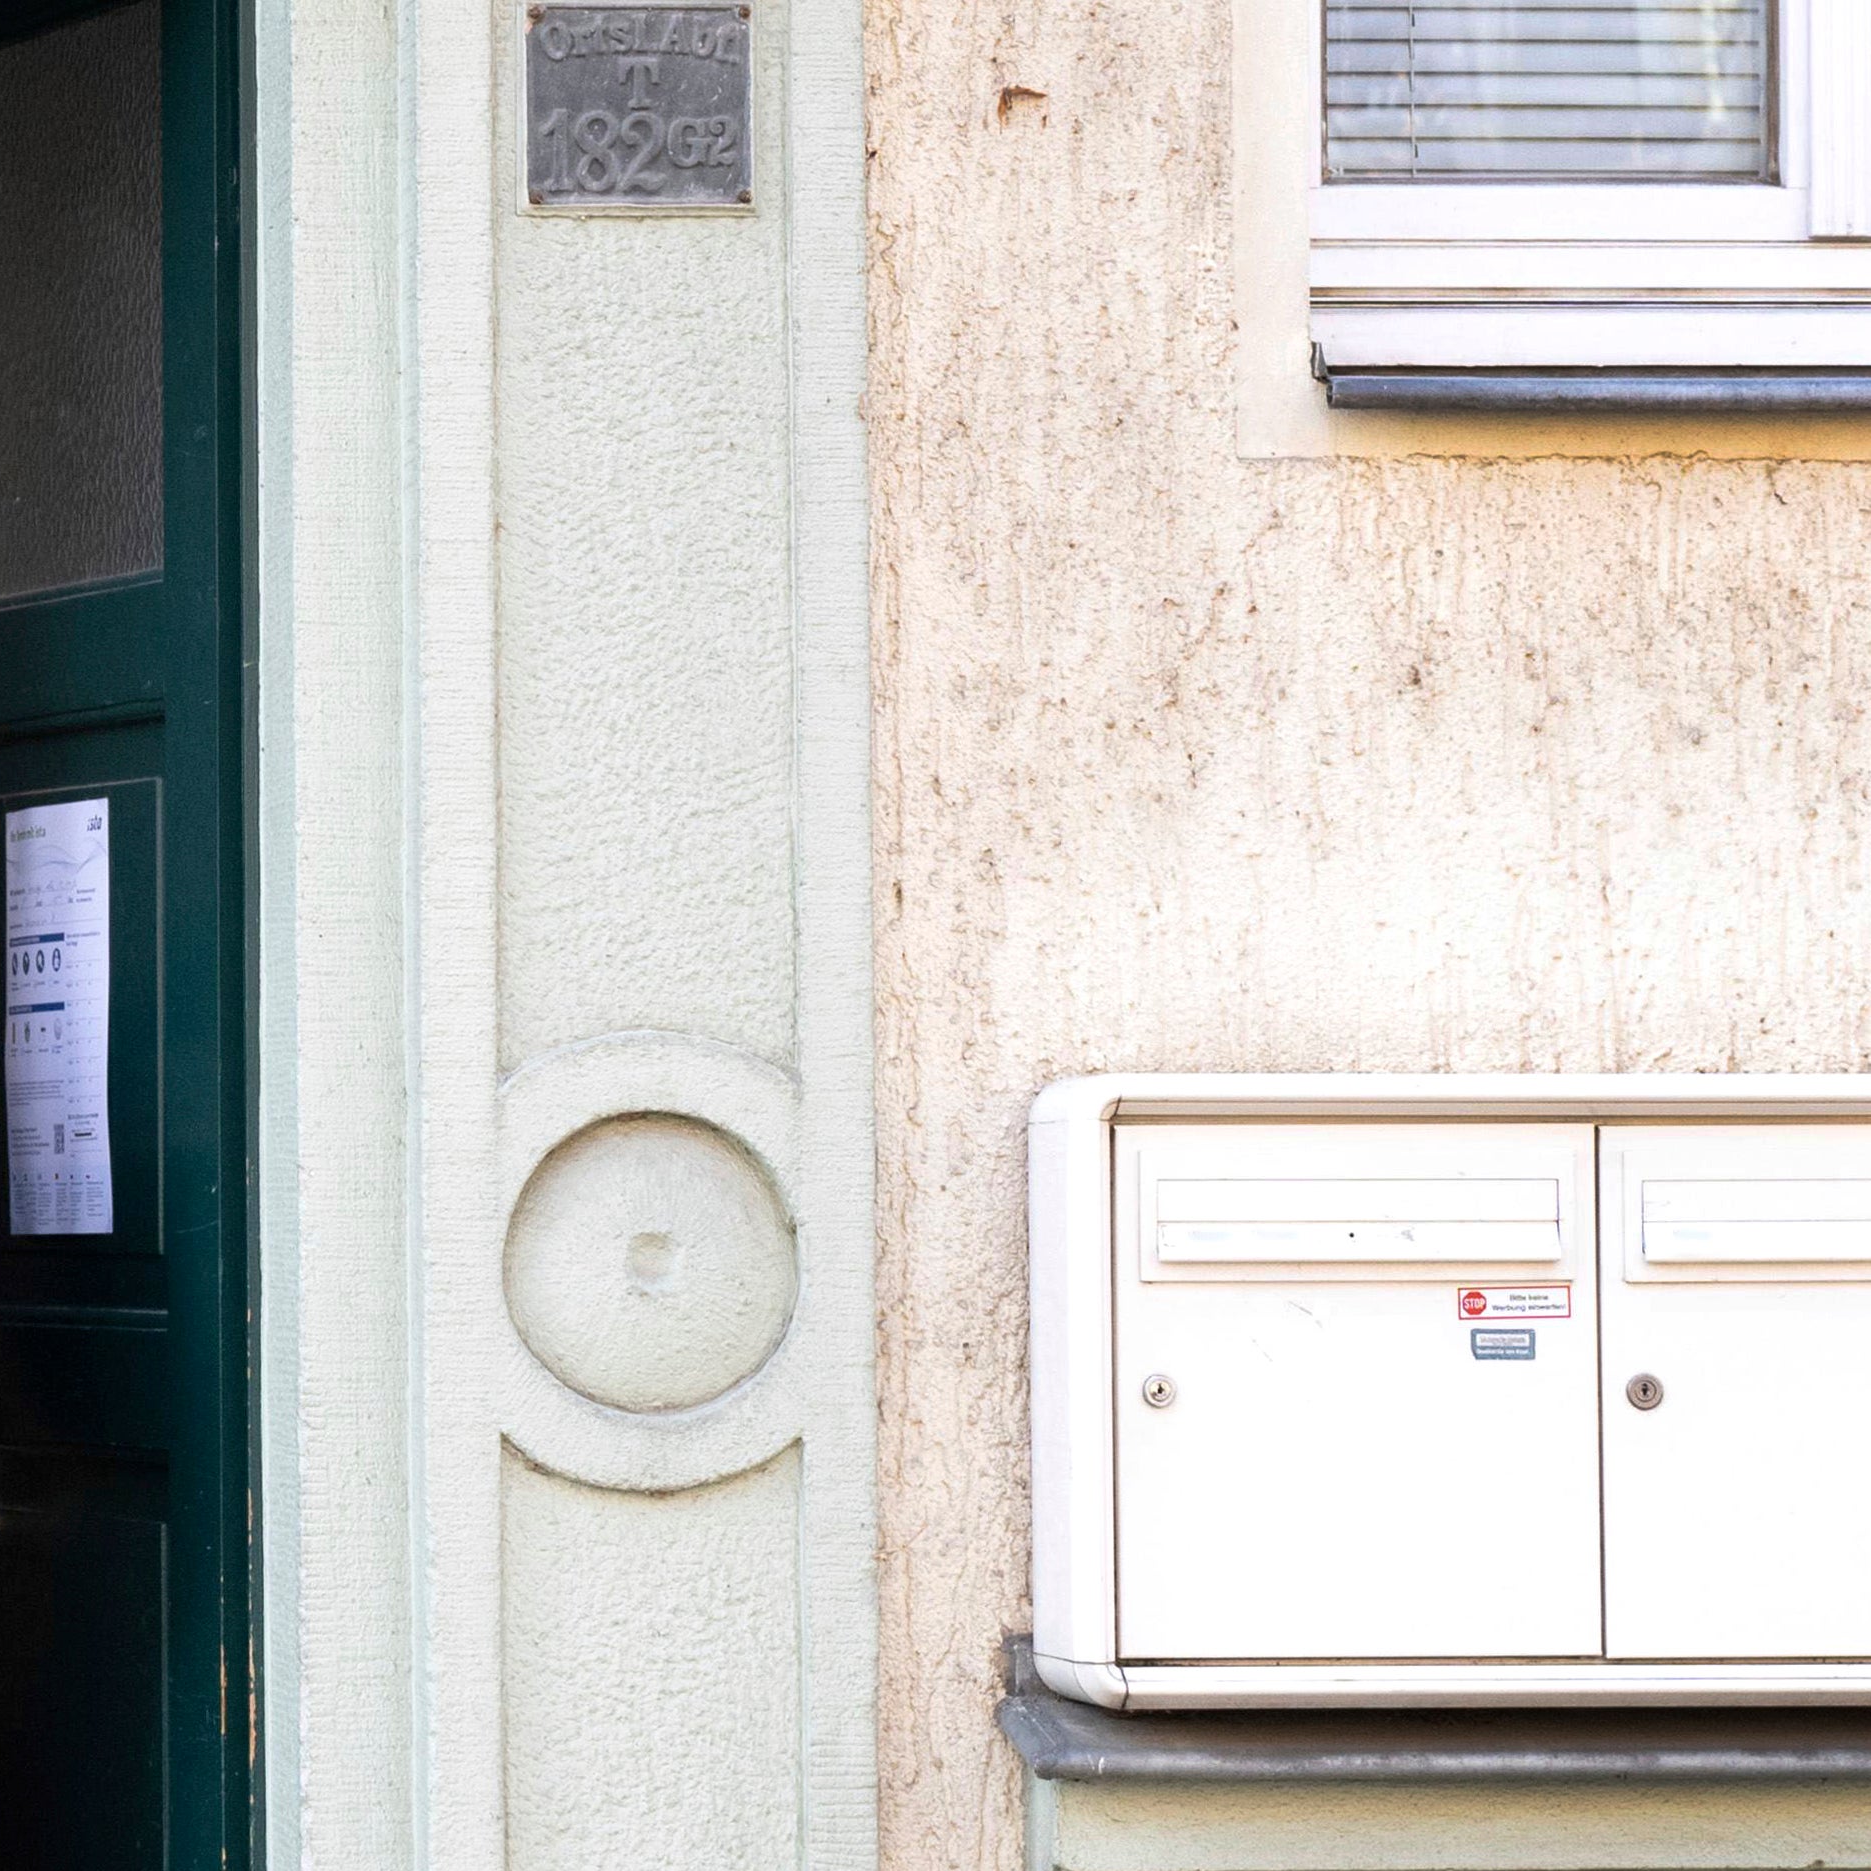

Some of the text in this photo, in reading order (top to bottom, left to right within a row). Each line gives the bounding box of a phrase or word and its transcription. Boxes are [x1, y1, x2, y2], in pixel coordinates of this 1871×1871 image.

[615, 56, 660, 110] T
[538, 108, 667, 193] 182
[1463, 1297, 1486, 1309] STOP
